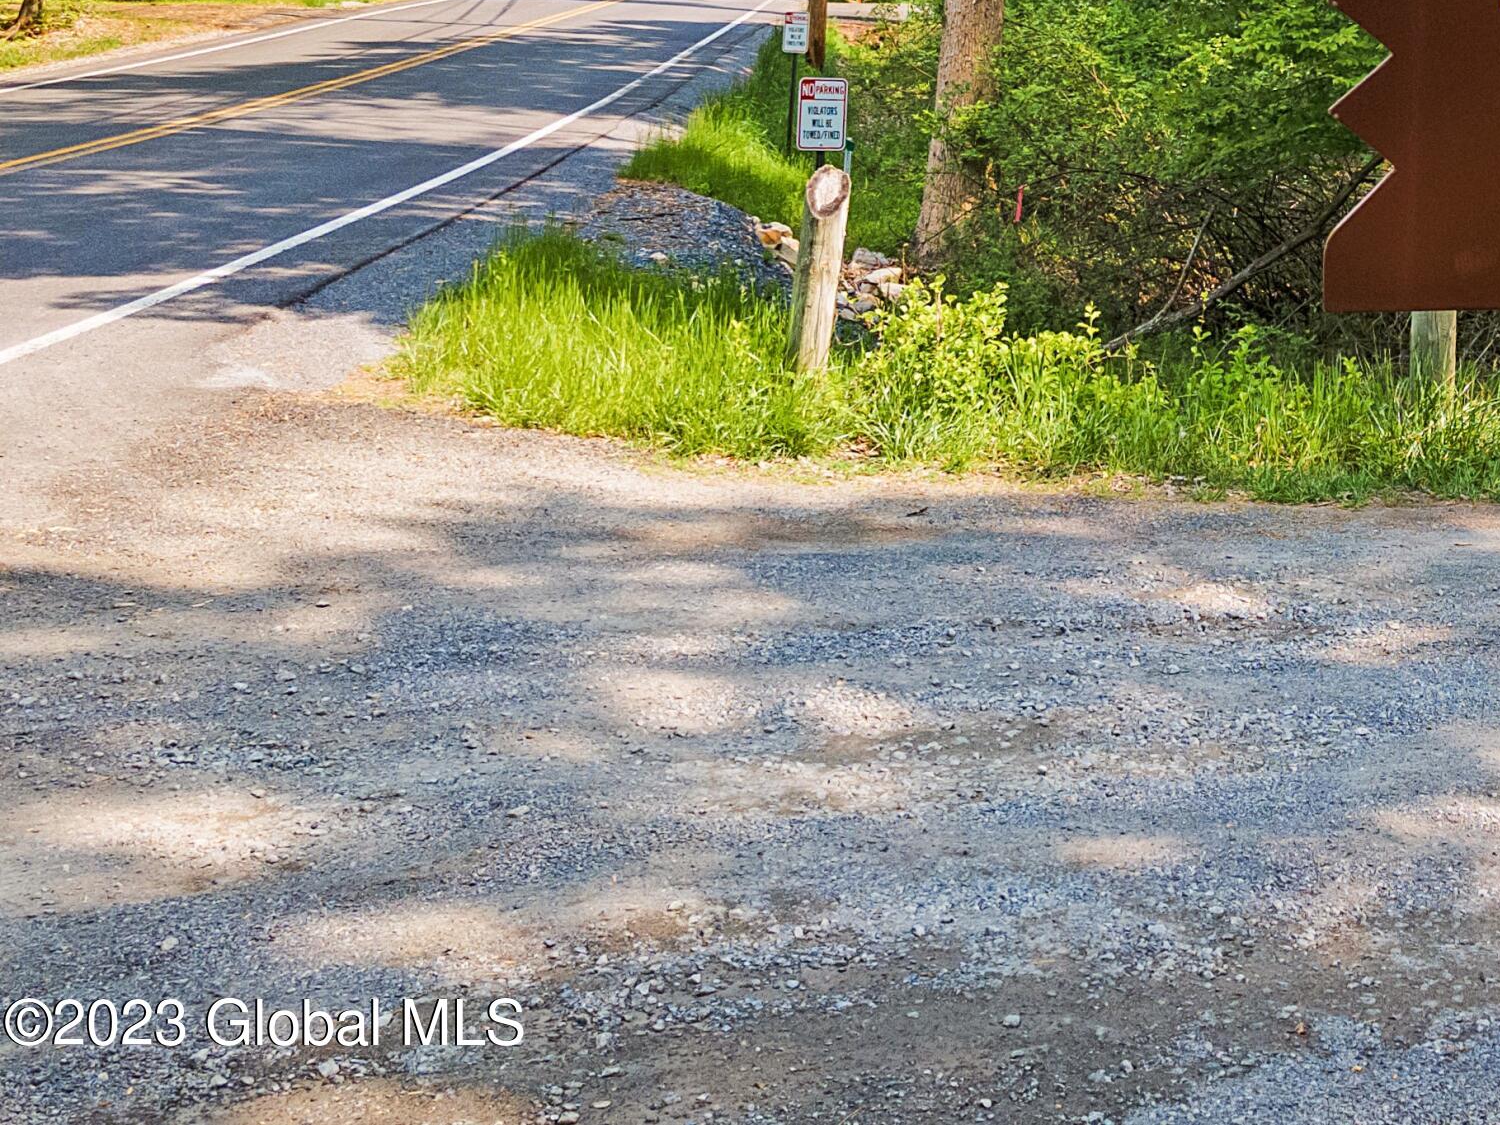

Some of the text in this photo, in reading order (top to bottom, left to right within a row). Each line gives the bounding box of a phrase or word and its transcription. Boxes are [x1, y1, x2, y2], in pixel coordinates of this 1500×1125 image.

[802, 83, 845, 97] NO PARKING
[808, 106, 838, 115] VIOLATORS
[812, 119, 833, 128] WILL BE
[804, 130, 840, 139] TOWED/FINED
